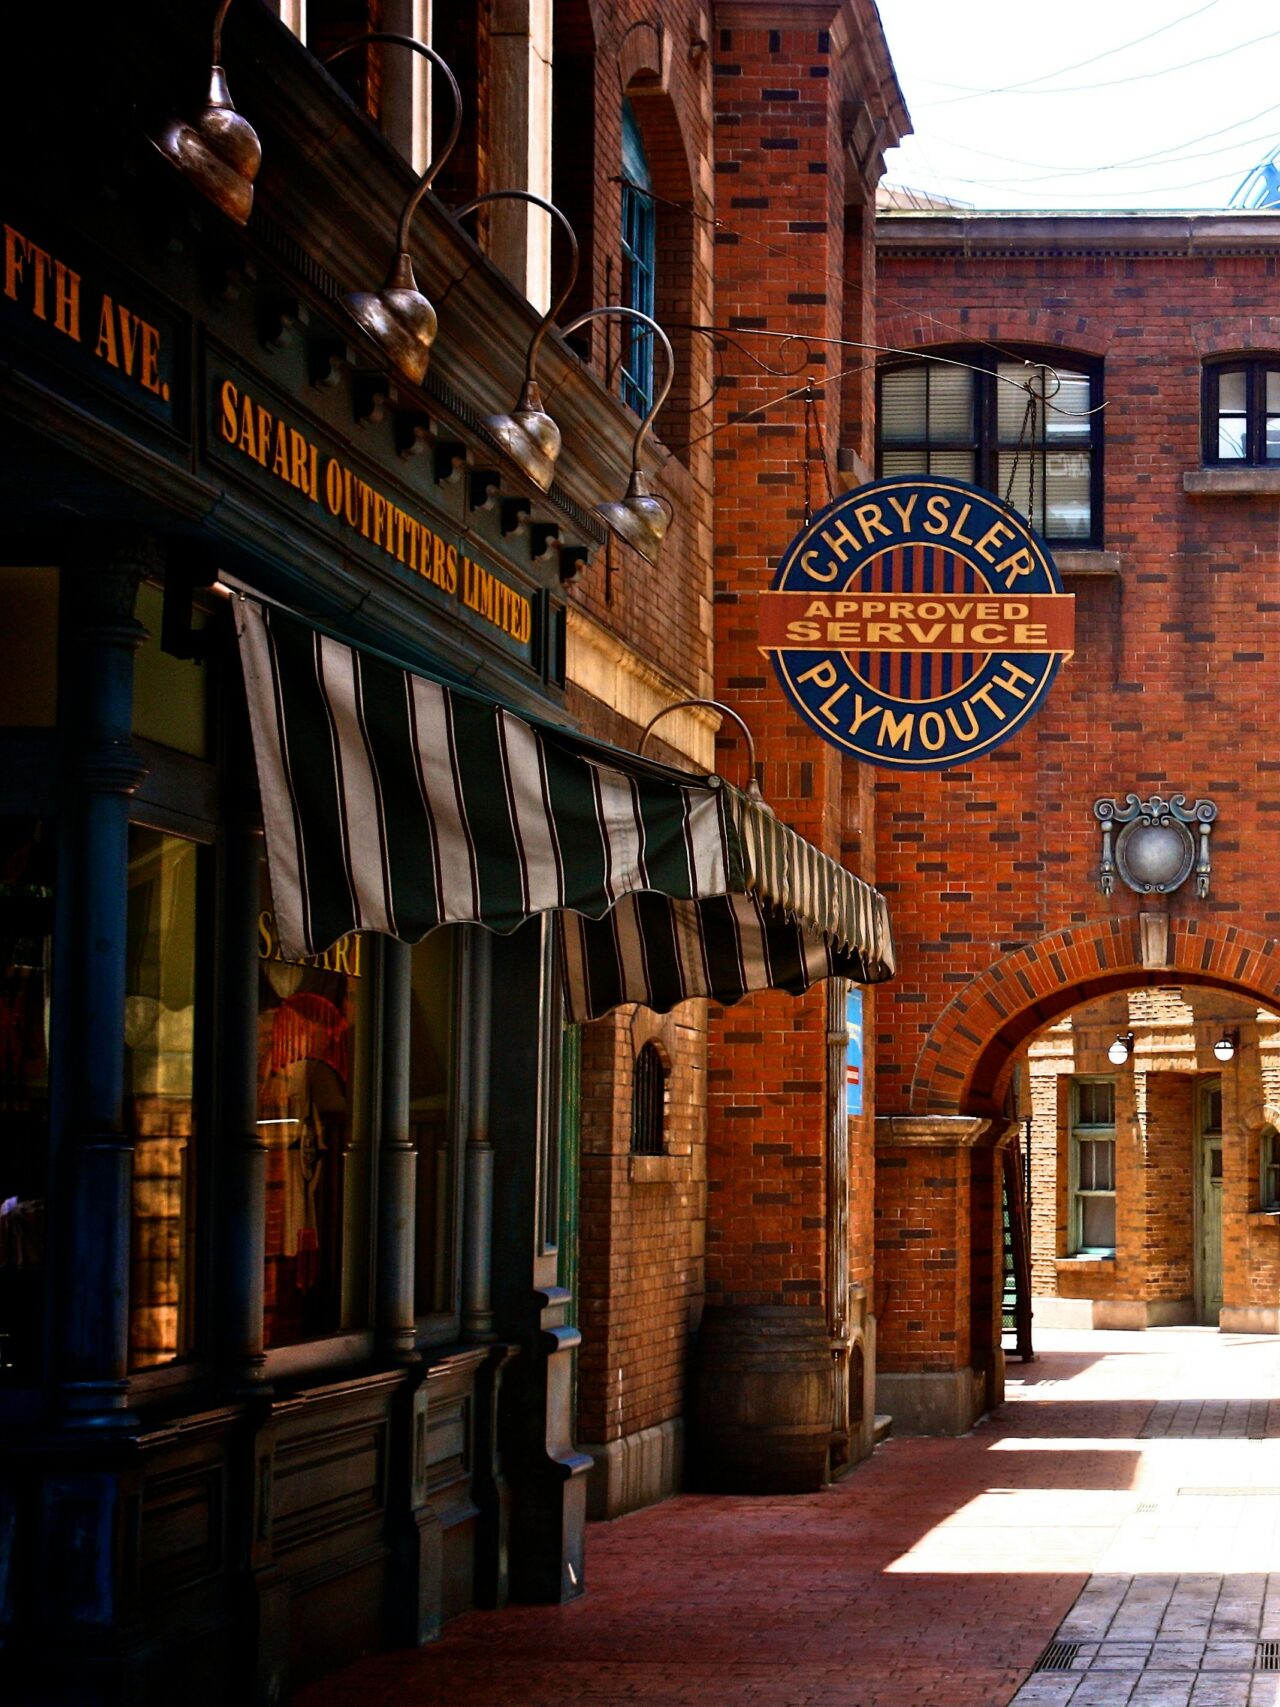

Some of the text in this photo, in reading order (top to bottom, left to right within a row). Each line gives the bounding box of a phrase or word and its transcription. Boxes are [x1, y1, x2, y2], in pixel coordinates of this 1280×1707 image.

[95, 294, 170, 402] AVE.
[221, 380, 532, 644] SAFARI OUTFITTERS LIMITED
[800, 493, 1035, 589] CHRYSLER
[785, 621, 1048, 644] SERVICE
[804, 601, 1030, 620] APPROVED
[796, 659, 1036, 751] PLYMOUTH
[258, 910, 362, 977] SRI
